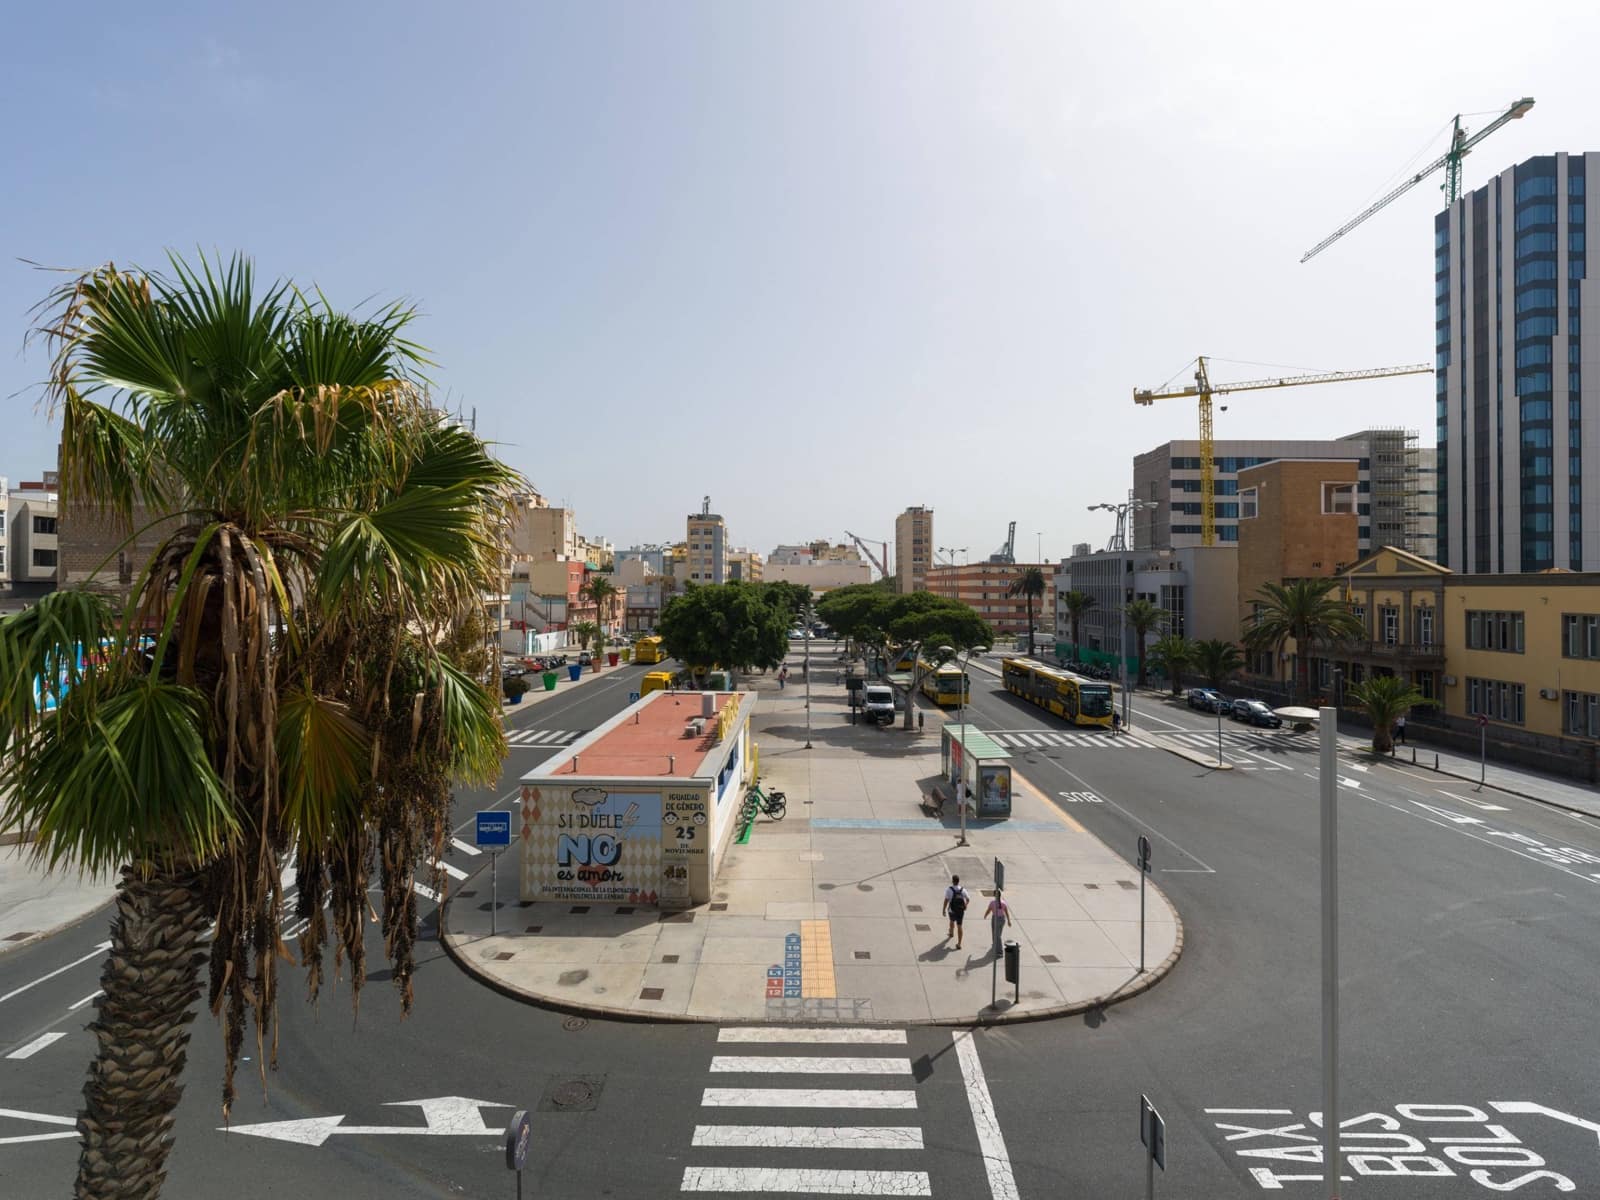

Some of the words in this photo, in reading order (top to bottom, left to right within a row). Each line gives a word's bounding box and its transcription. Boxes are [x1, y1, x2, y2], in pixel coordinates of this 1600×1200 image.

[669, 793, 700, 801] IGUALDAD
[1058, 791, 1104, 803] BUS
[665, 803, 674, 811] DE
[558, 814, 574, 828] SI
[579, 814, 623, 829] DUELE
[675, 826, 696, 840] 25
[557, 833, 622, 867] NO
[557, 870, 576, 881] es
[577, 868, 625, 882] amor
[1203, 1108, 1353, 1189] TAXI
[1308, 1112, 1457, 1176] BUS
[1394, 1103, 1576, 1192] SOLO
